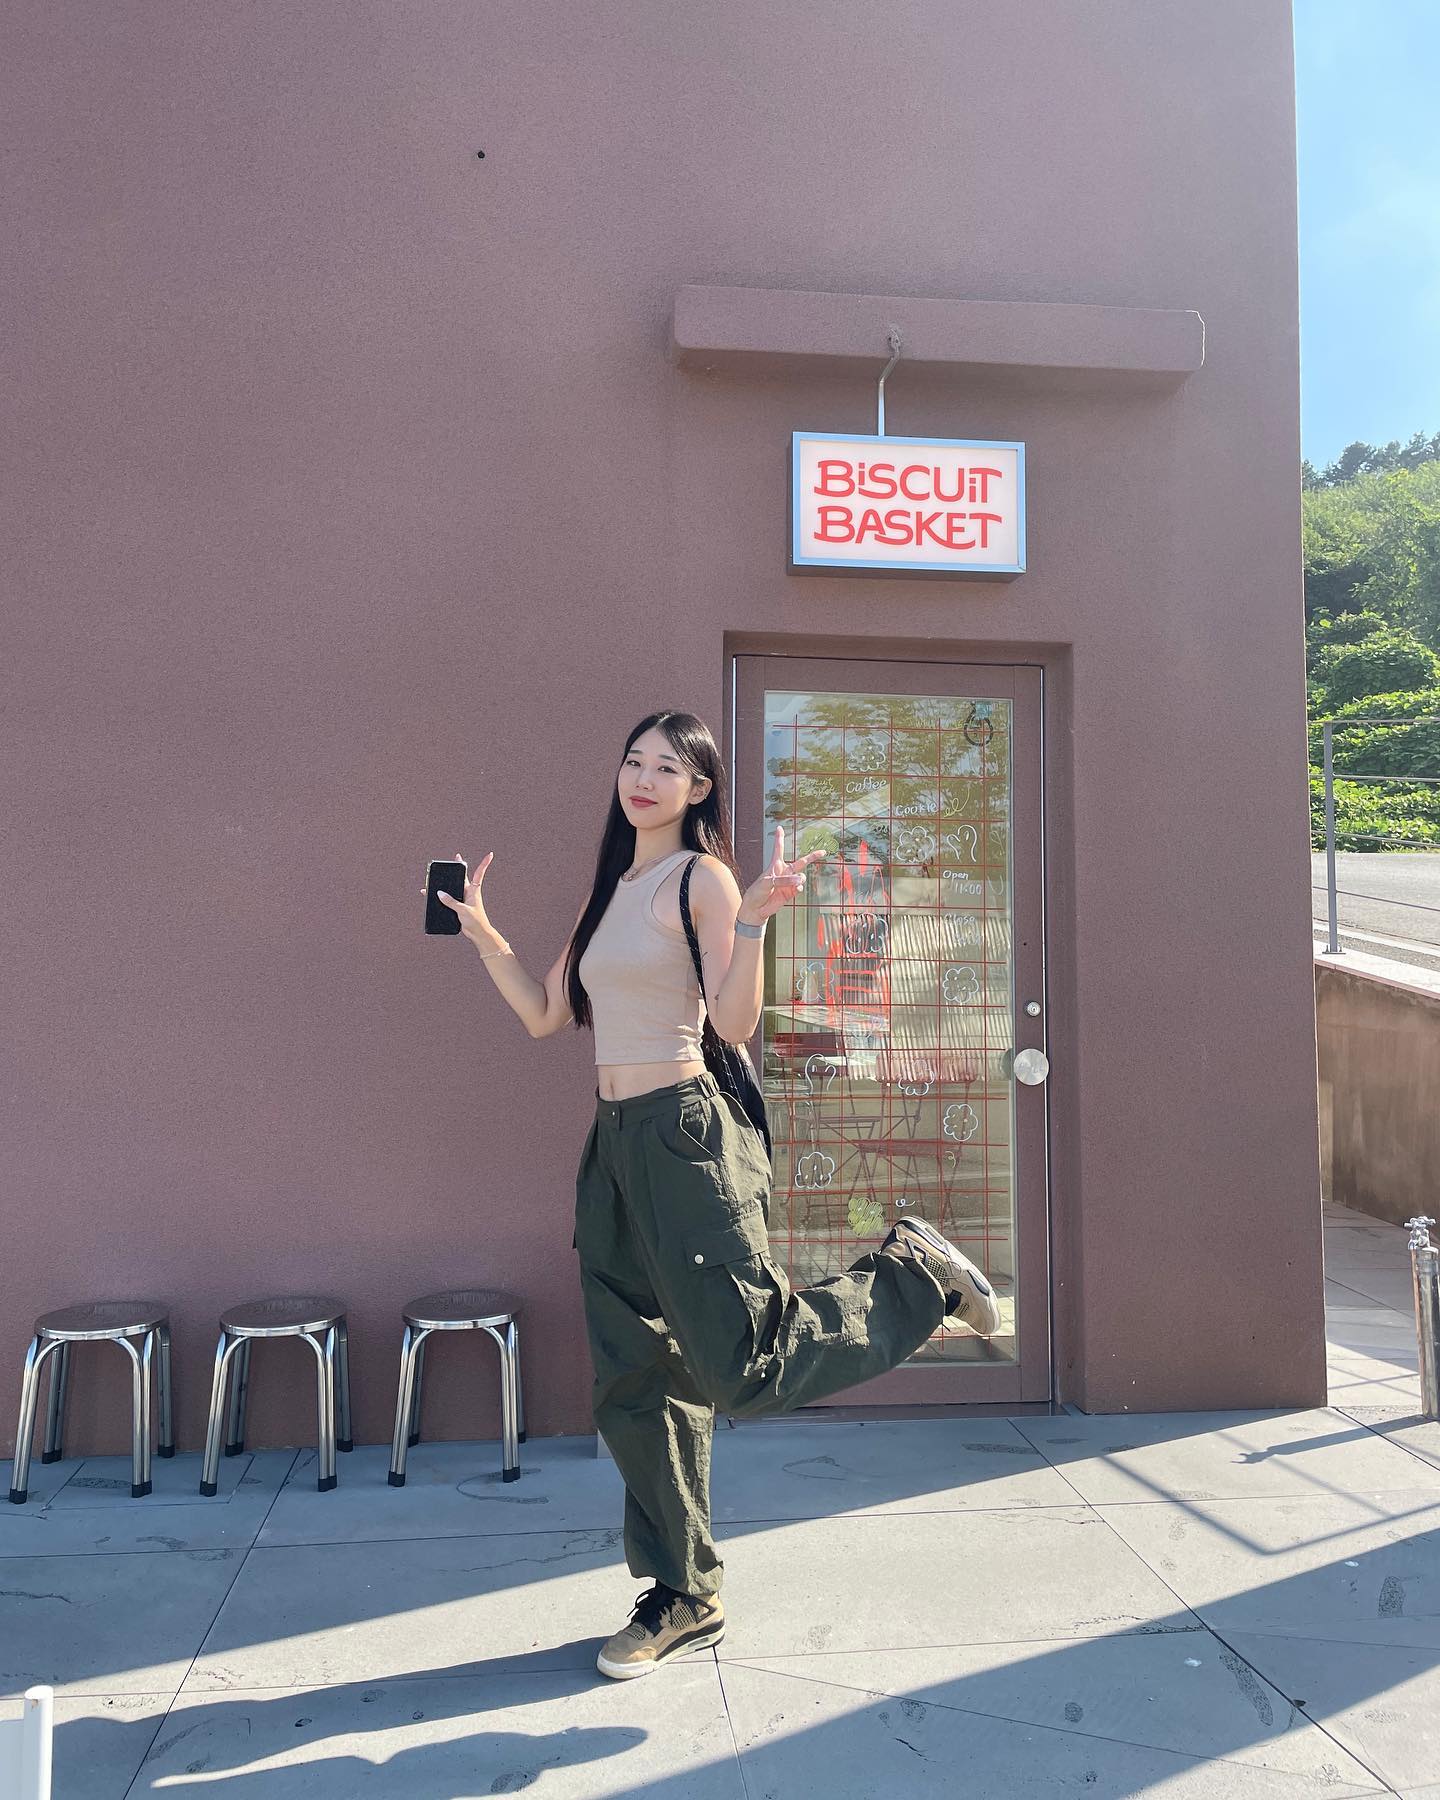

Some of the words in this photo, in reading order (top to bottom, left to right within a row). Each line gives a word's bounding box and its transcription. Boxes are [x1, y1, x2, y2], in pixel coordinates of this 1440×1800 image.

[813, 505, 1002, 550] BASKET
[846, 776, 886, 793] Coffee
[895, 803, 938, 816] Cookie
[942, 870, 969, 883] Open
[955, 882, 982, 895] 11:00
